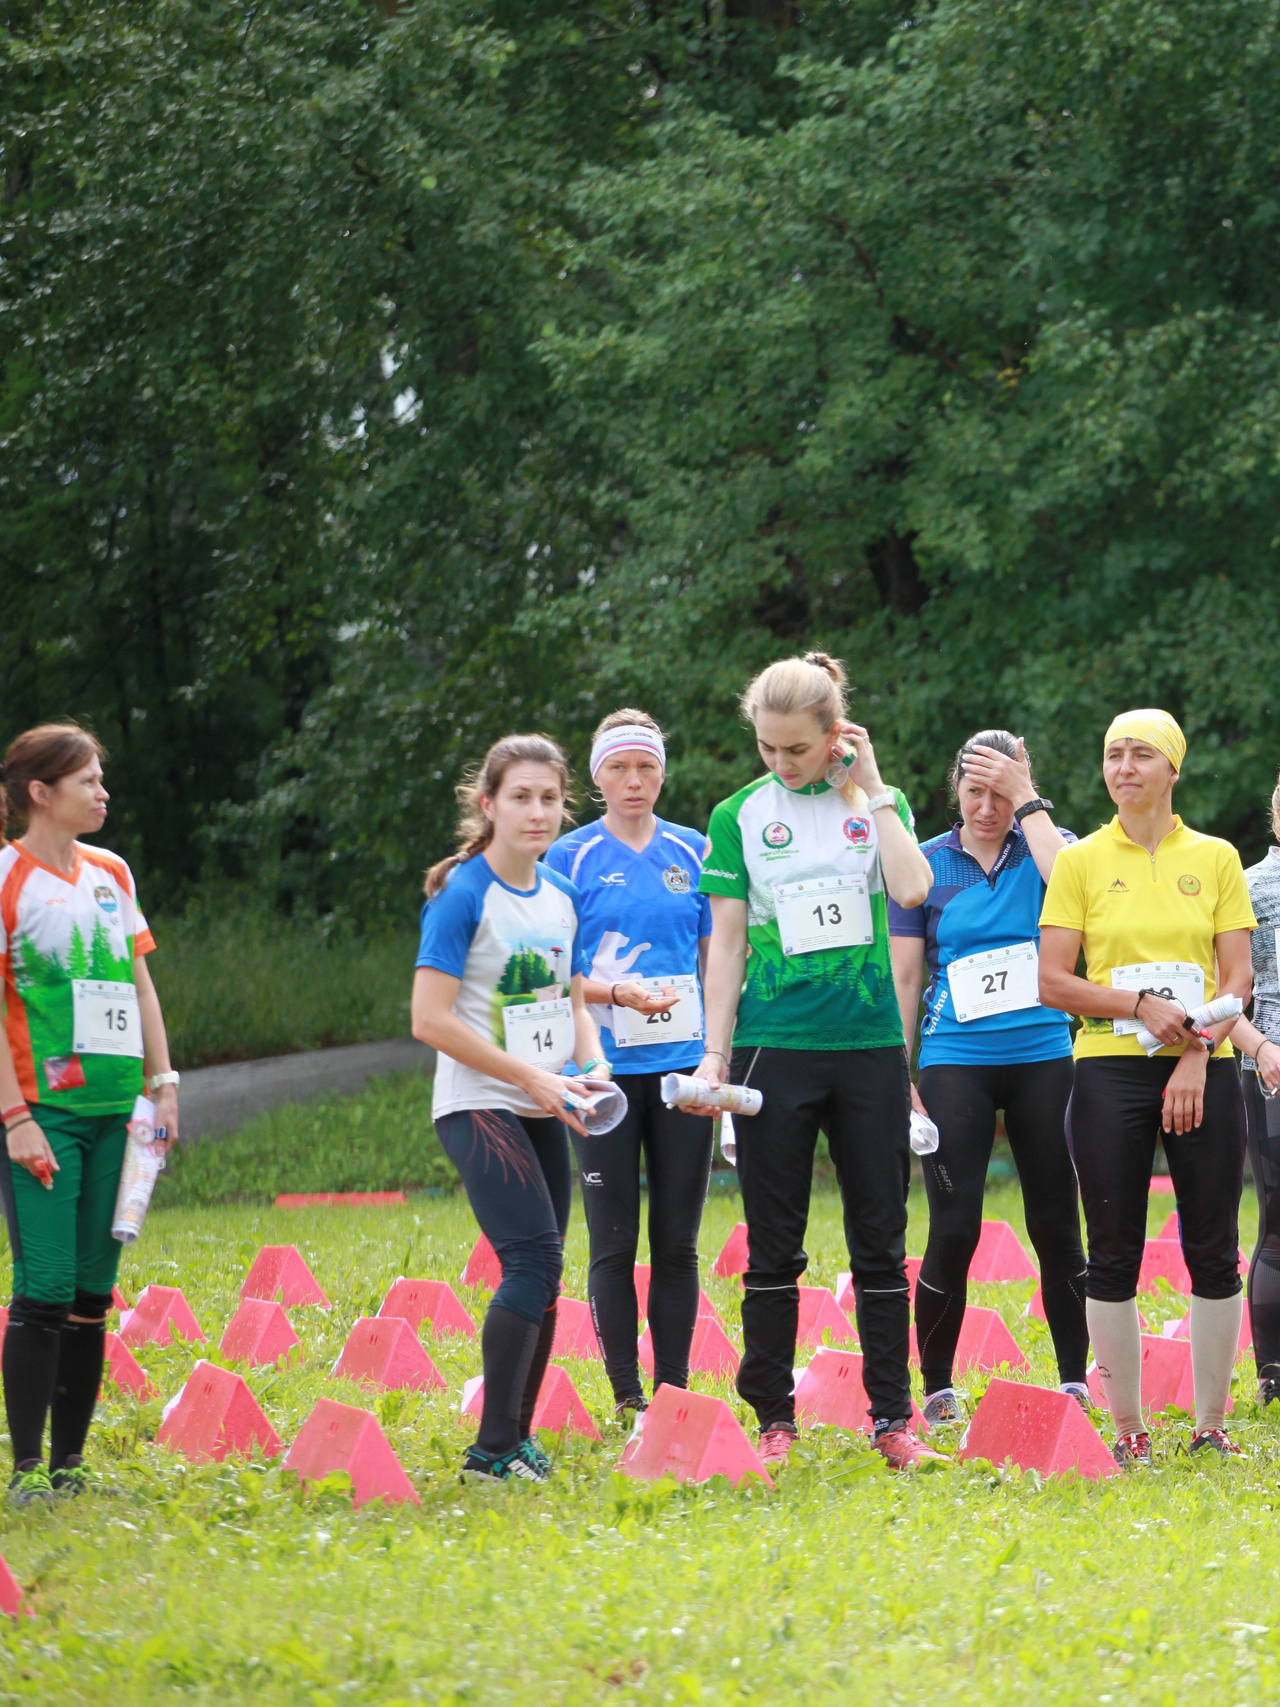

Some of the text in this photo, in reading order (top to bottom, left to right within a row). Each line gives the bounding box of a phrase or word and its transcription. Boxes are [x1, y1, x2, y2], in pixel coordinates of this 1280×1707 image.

[812, 903, 842, 926] 13
[981, 970, 1008, 995] 27
[105, 1007, 128, 1031] 15
[532, 1028, 554, 1053] 14
